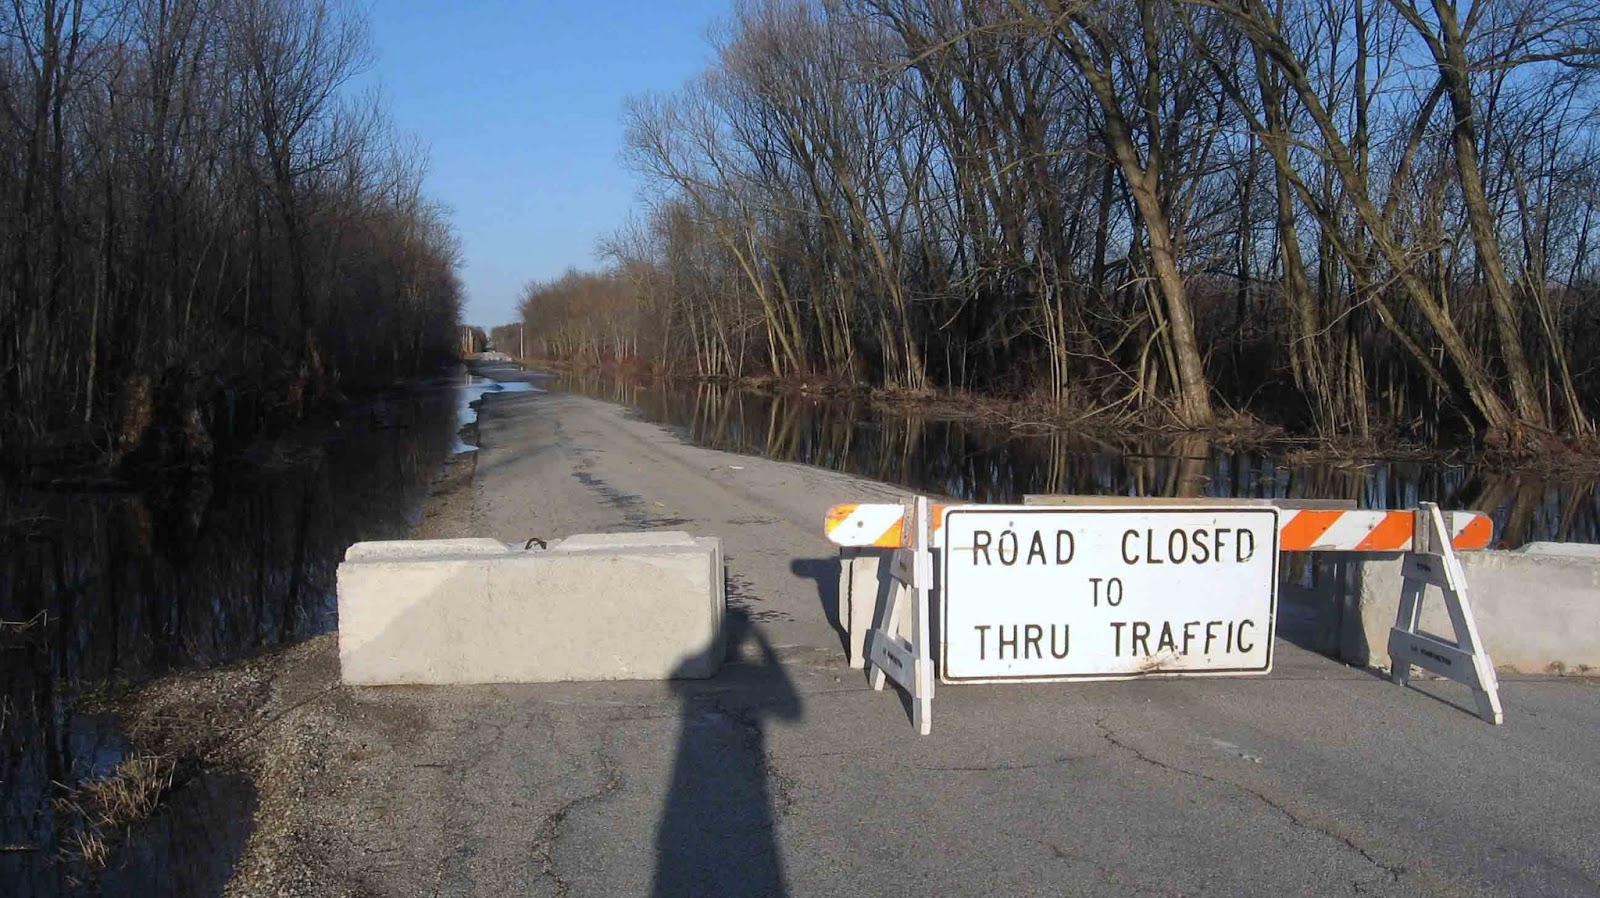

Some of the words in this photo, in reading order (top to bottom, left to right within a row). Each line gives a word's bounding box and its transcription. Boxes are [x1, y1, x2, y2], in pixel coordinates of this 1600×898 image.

[972, 529, 1075, 566] ROAD
[1088, 577, 1123, 607] TO
[974, 624, 1070, 660] THRU
[1110, 619, 1255, 657] TRAFFIC
